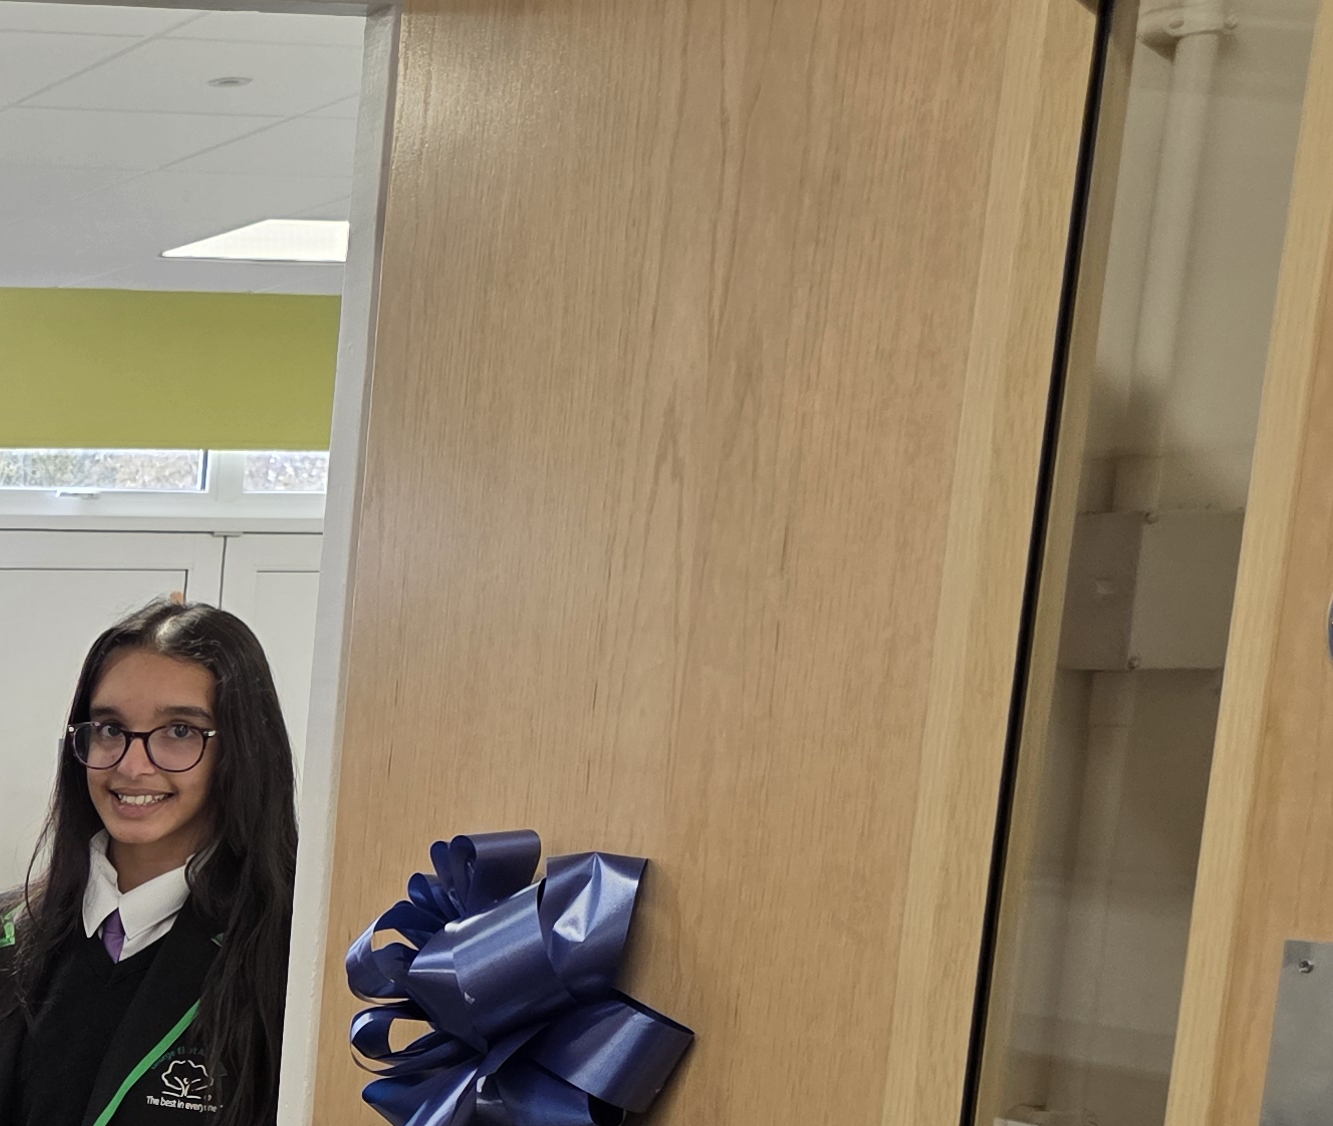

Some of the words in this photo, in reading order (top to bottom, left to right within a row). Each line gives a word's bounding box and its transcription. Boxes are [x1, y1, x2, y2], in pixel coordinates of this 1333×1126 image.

[146, 1095, 160, 1105] The
[160, 1097, 176, 1108] best
[177, 1100, 185, 1109] in
